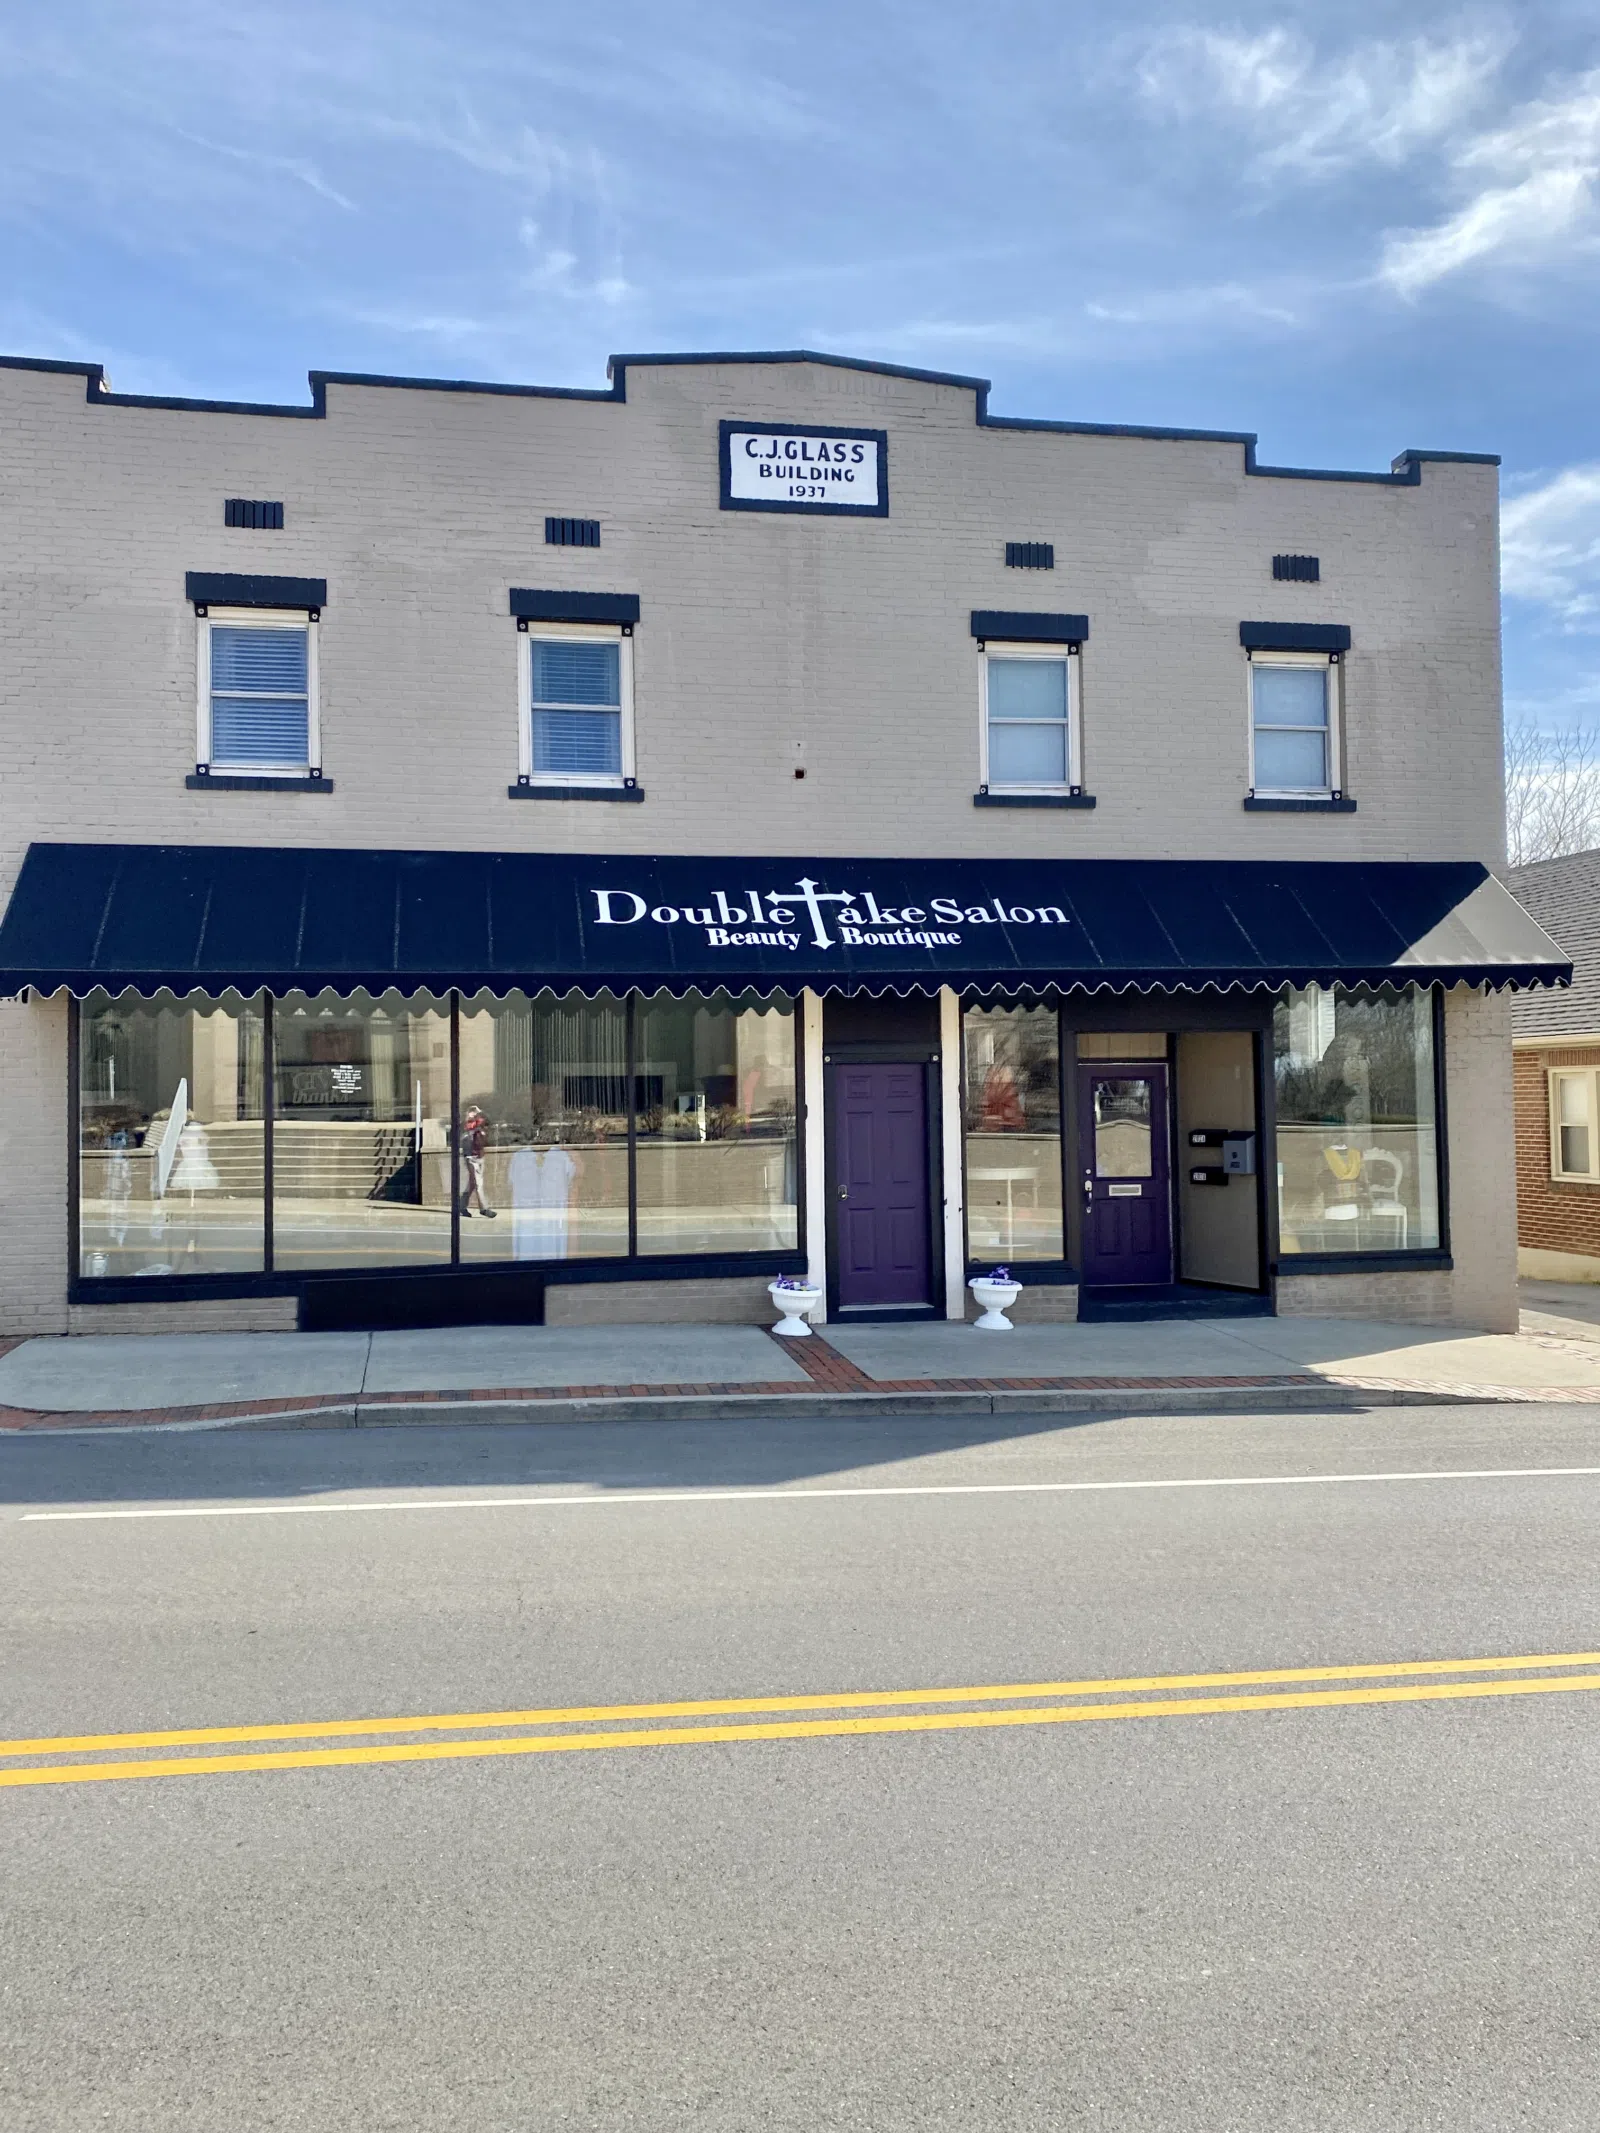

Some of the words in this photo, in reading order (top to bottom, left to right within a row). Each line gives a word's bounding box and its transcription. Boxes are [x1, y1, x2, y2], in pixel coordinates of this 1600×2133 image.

[759, 464, 855, 482] BUILDING
[789, 485, 826, 498] 1937
[589, 889, 796, 925] Double
[930, 898, 1071, 924] Salon
[705, 928, 802, 951] Beauty
[838, 927, 963, 949] Boutique
